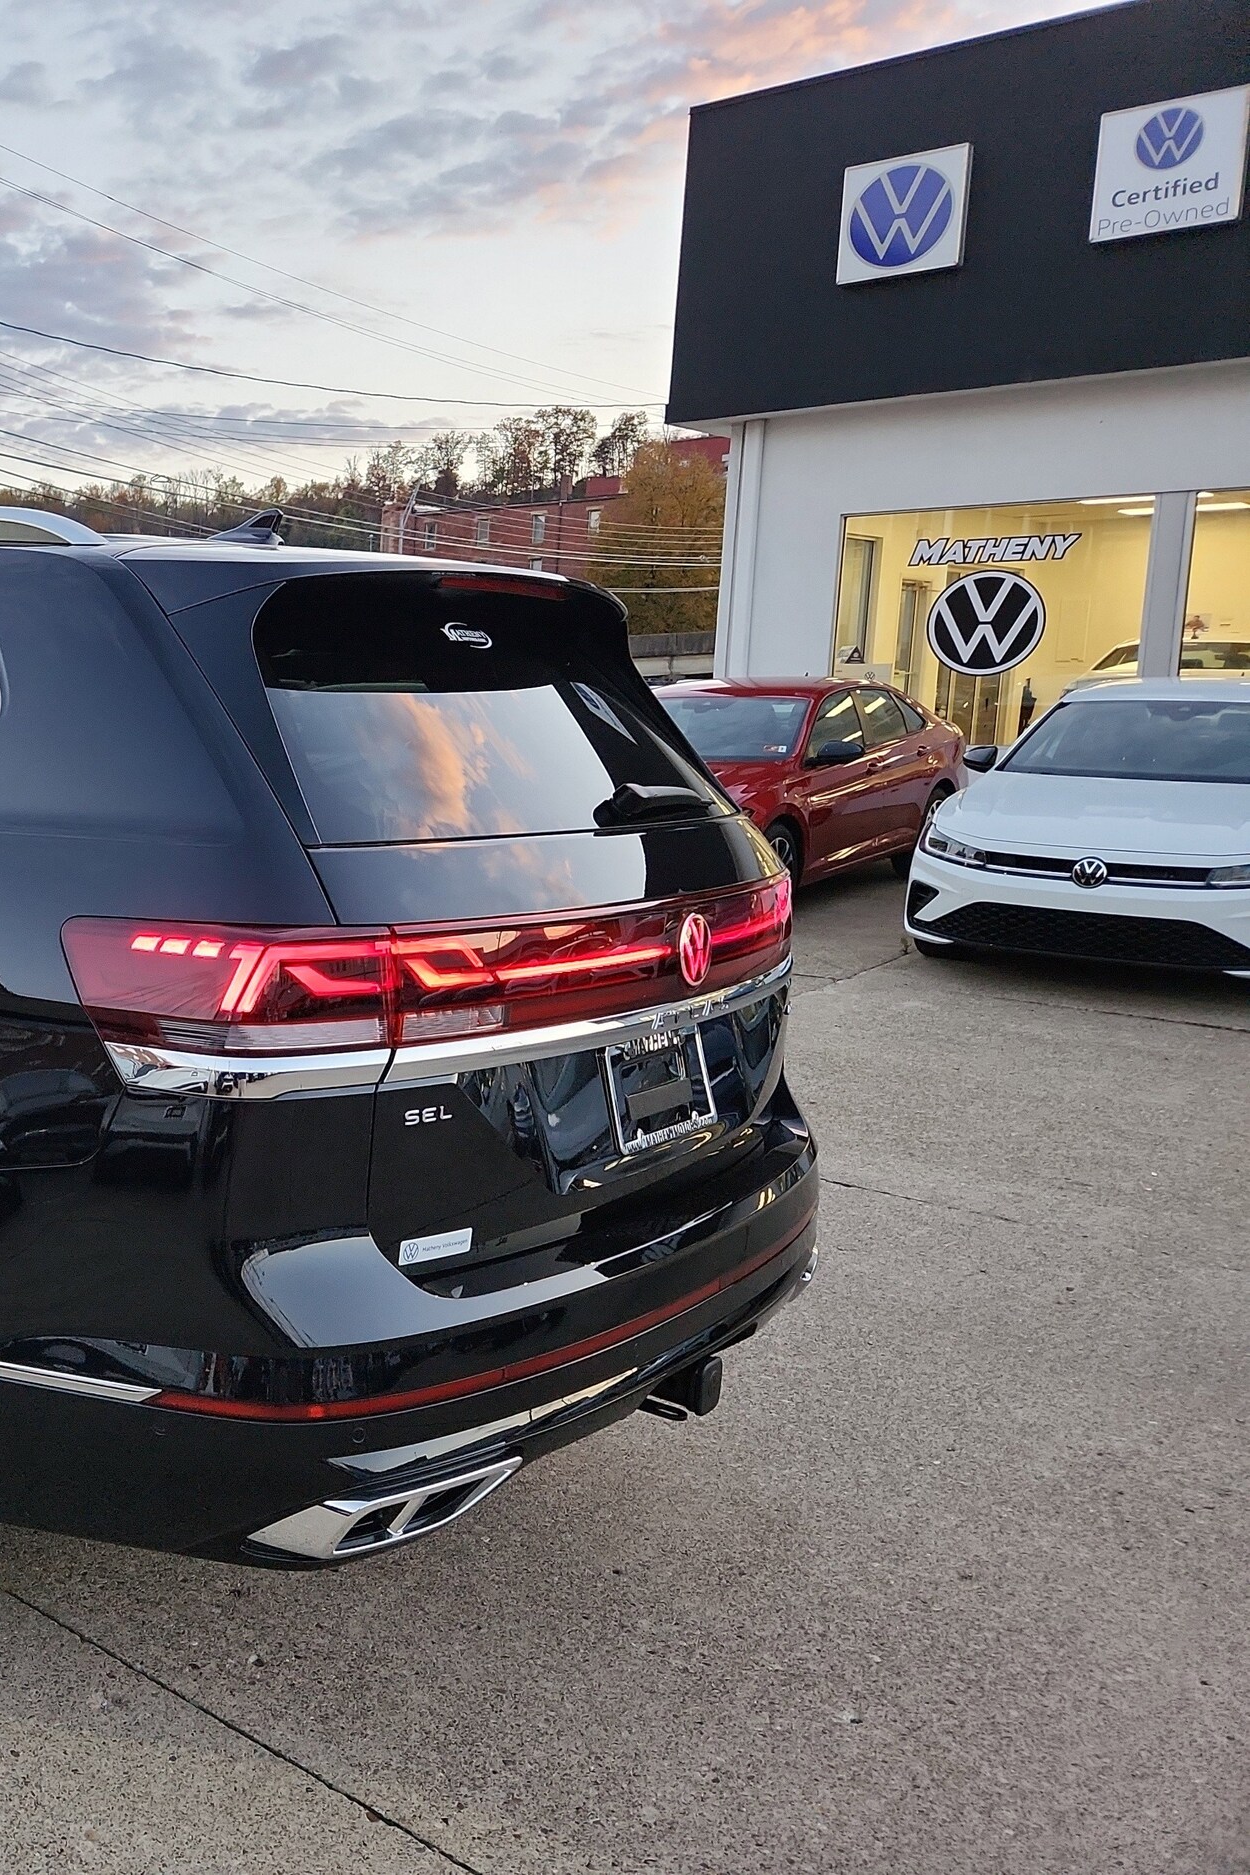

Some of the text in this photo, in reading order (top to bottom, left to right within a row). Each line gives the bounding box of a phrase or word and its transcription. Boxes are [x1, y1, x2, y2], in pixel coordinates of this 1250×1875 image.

[1112, 172, 1220, 208] Certified
[1098, 197, 1230, 236] Pre-Owned
[908, 533, 1082, 566] MATHENY
[404, 1105, 453, 1126] SEL
